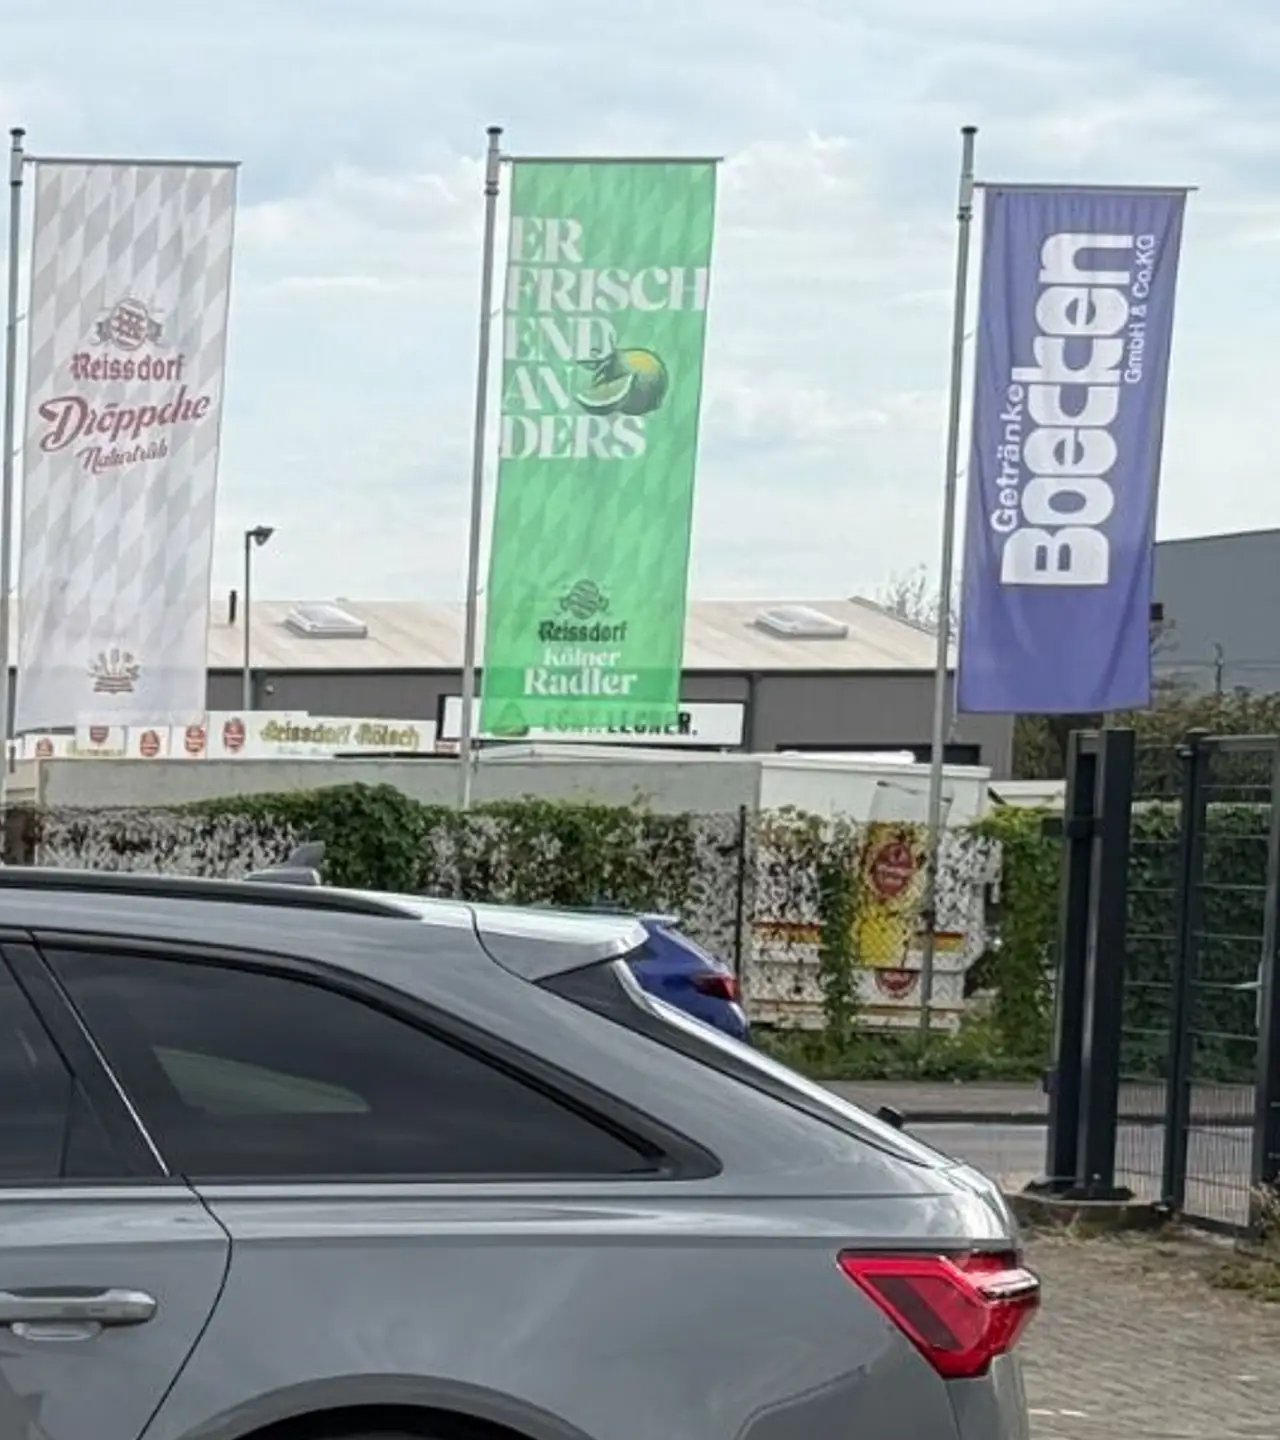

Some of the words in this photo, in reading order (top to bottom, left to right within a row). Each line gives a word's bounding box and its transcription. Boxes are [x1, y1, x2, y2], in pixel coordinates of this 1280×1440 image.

[510, 216, 584, 263] ER
[506, 265, 708, 312] FRISCH
[1131, 304, 1147, 317] &
[504, 316, 617, 361] END
[1124, 323, 1147, 383] GmbH
[70, 352, 185, 381] Reissdorf
[38, 384, 210, 452] Dröppche
[1001, 232, 1133, 584] Boecken
[499, 414, 647, 460] DERS
[991, 384, 1025, 532] Getränke
[538, 620, 627, 642] Reissdorf
[543, 647, 621, 668] Kölner
[522, 667, 638, 696] Radler
